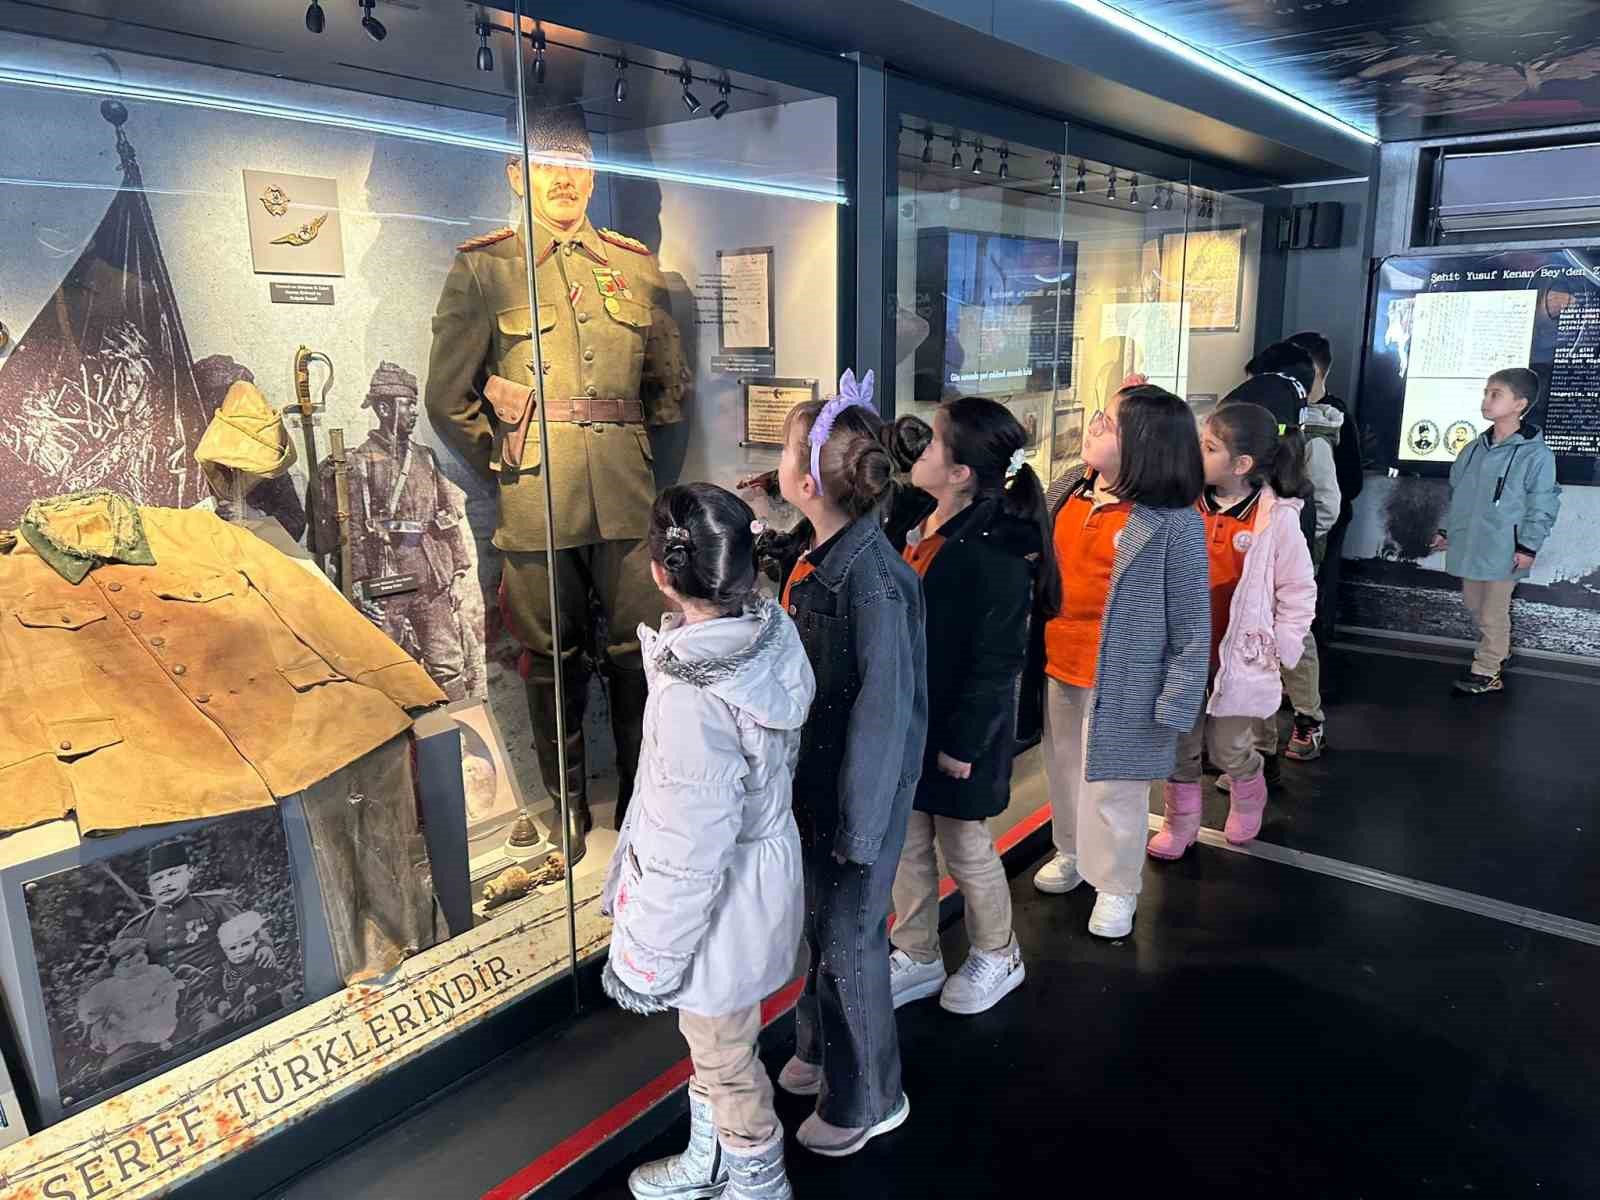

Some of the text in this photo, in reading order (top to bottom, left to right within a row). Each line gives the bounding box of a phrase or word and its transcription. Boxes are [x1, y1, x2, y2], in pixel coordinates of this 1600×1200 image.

[1466, 270, 1498, 281] Yusuf
[1503, 269, 1535, 279] Kenan
[223, 955, 521, 1119] TÜRKLERİNDİR.
